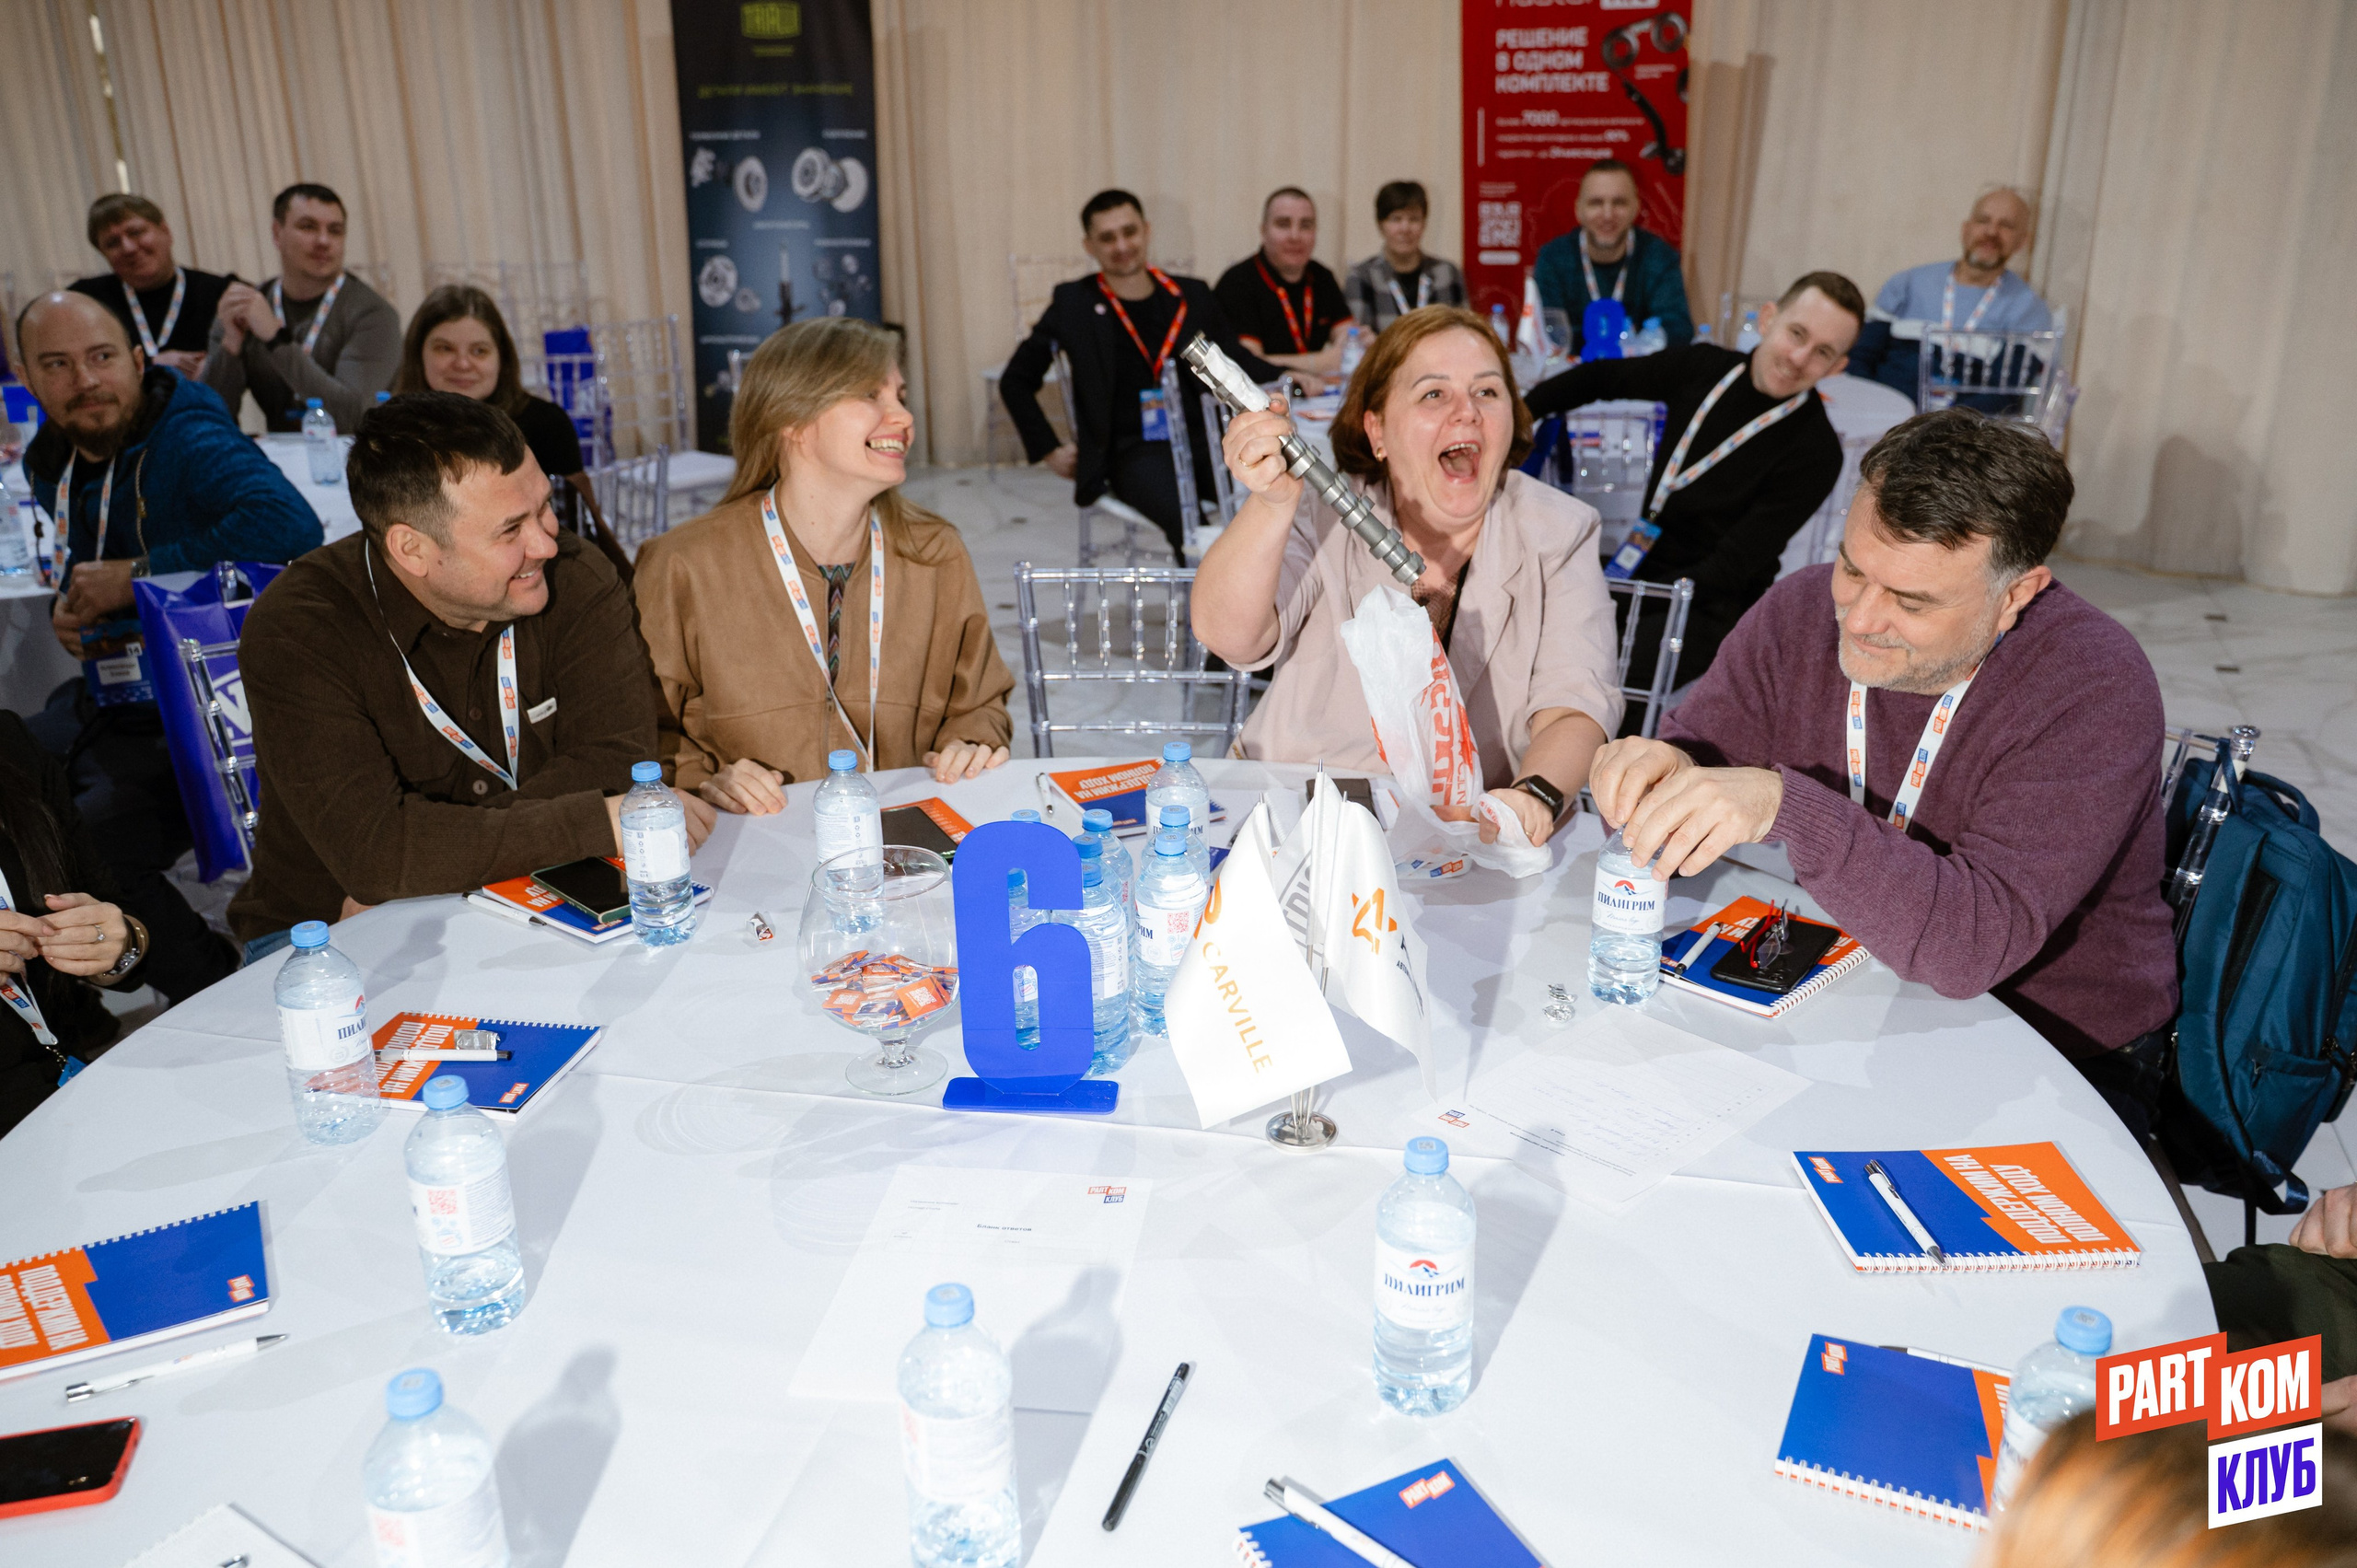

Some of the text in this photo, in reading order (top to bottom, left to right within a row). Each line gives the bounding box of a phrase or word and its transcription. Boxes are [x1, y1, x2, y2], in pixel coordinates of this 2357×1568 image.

[1495, 26, 1589, 49] РЕШЕНИЕ
[1513, 50, 1585, 72] ОДНОМ
[1495, 71, 1610, 93] КОМПЛЕКТЕ
[1074, 773, 1155, 800] ОДДЕРЖИМ НА
[1078, 764, 1155, 790] ПОЛНОМ ХОДУ
[1597, 890, 1655, 911] ПИЛИГРИМ
[952, 820, 1095, 1094] 6
[1202, 941, 1272, 1074] CARVILLE
[383, 1021, 426, 1051] ПОЛНО
[380, 1024, 454, 1094] ПОДДЖИМ НА
[1944, 1154, 2072, 1243] ПОДДЕРЖИМ НА
[1989, 1164, 2110, 1243] ПОЛНОМ ХОДУ
[1385, 1272, 1465, 1296] ПИЛИГРИМ
[17, 1263, 89, 1352] ПОДДЕРЖИМ НА
